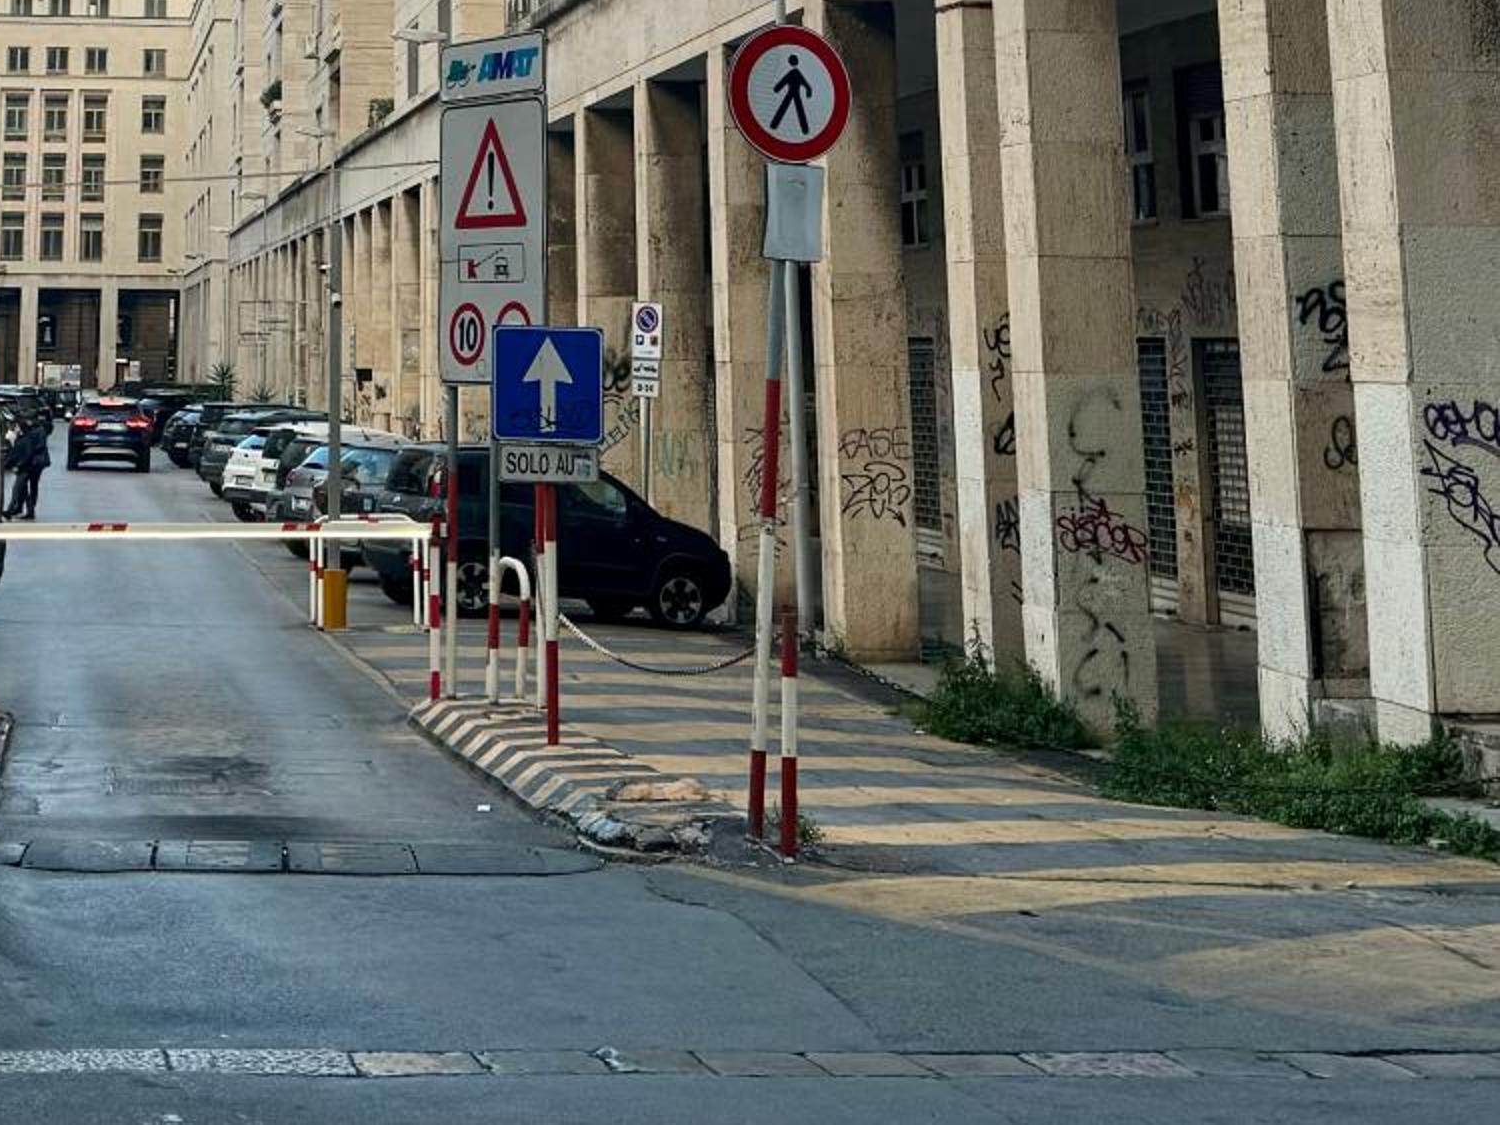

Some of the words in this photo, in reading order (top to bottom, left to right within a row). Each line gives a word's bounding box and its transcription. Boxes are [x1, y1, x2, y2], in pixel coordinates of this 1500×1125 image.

[458, 316, 478, 352] 10
[838, 426, 913, 459] FASE
[506, 452, 550, 475] SOLO
[556, 452, 591, 476] AU
